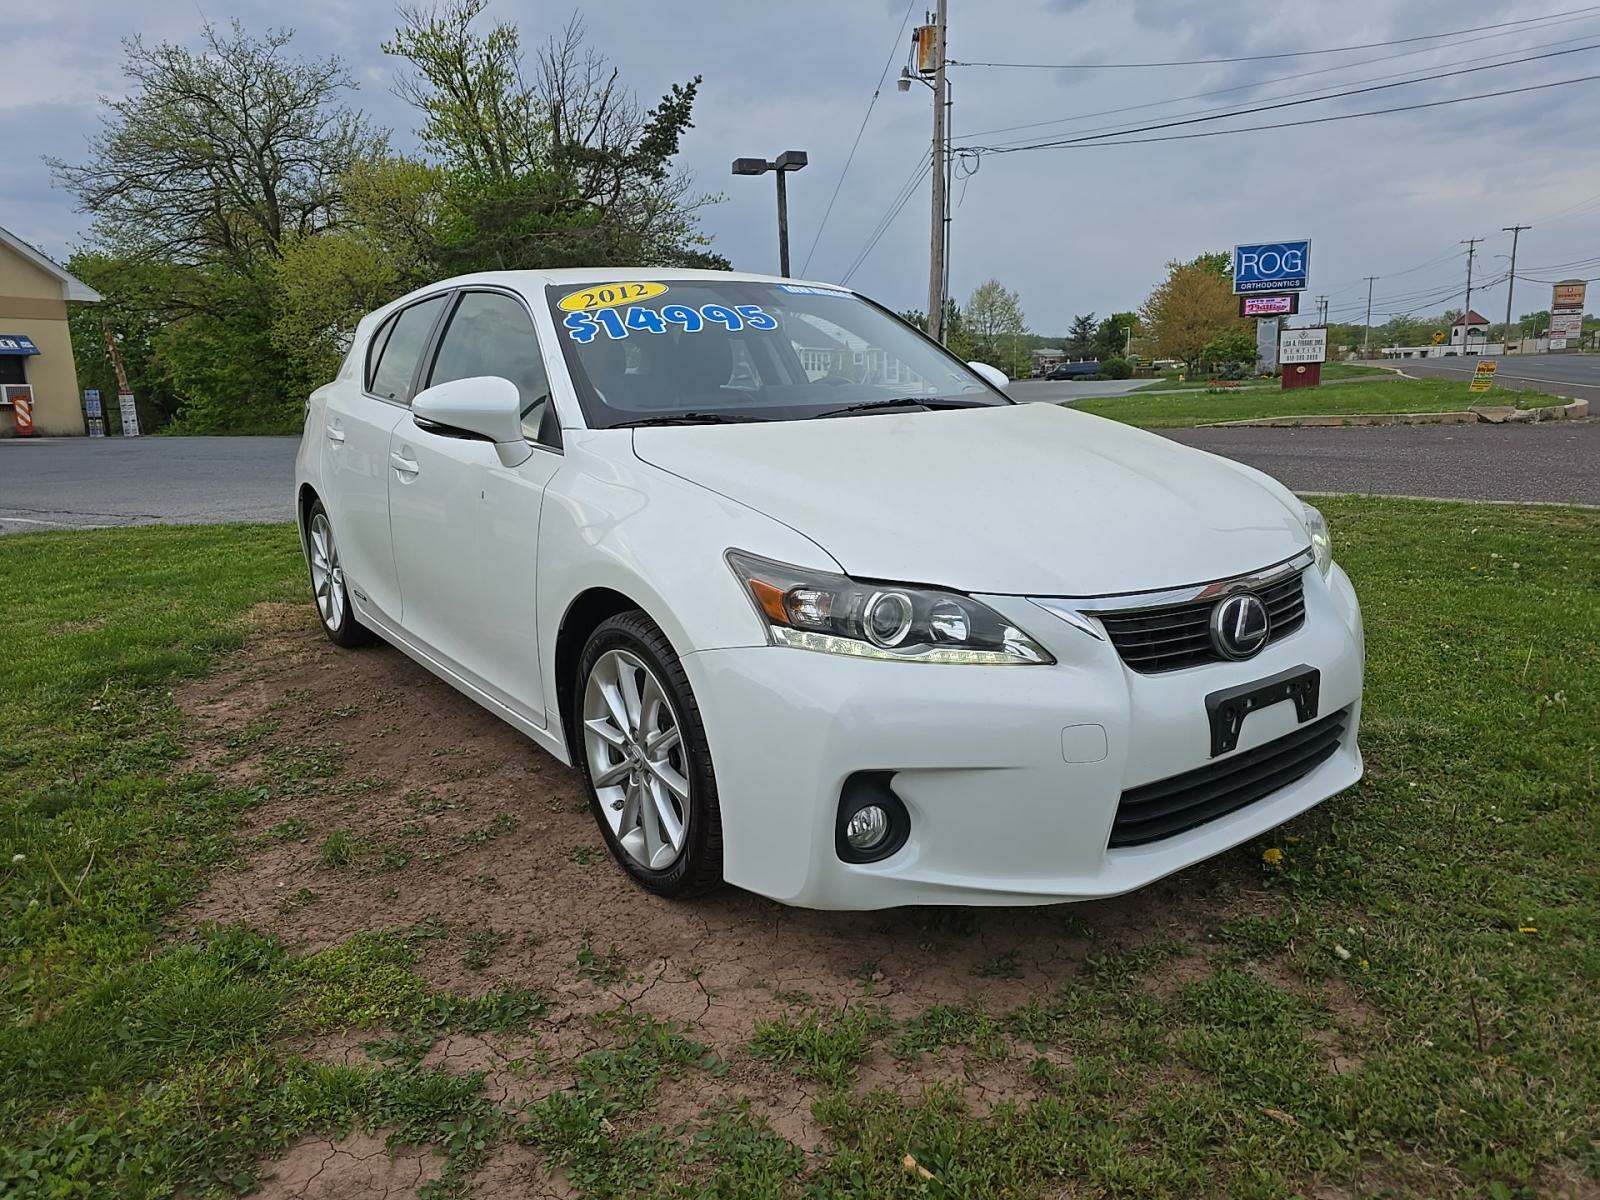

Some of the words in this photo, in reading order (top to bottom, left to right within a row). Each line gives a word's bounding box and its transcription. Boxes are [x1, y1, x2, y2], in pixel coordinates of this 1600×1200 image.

[1240, 249, 1302, 276] ROG
[580, 283, 648, 308] 2012
[1240, 280, 1300, 290] ORTHODONTICS
[563, 303, 778, 343] $14995
